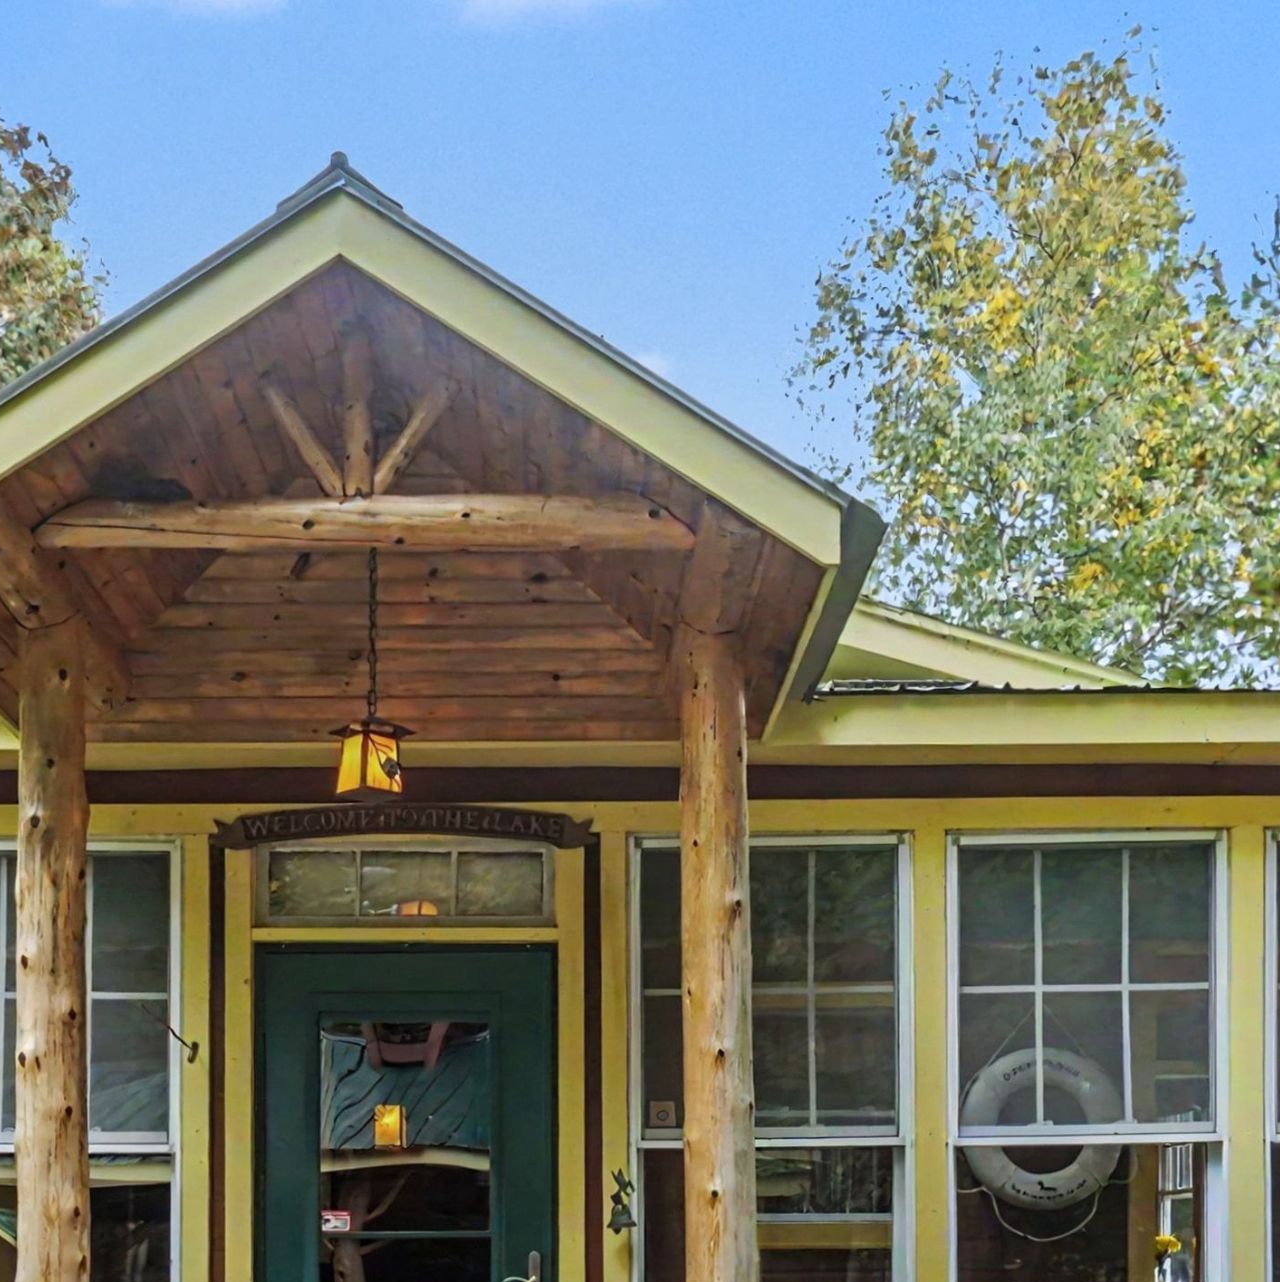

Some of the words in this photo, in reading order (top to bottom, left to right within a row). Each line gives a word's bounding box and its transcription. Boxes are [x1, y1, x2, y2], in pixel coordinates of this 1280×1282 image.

[245, 808, 374, 837] WELCOME
[384, 808, 417, 828] TO
[426, 808, 480, 830] THE
[493, 811, 562, 838] LAKE
